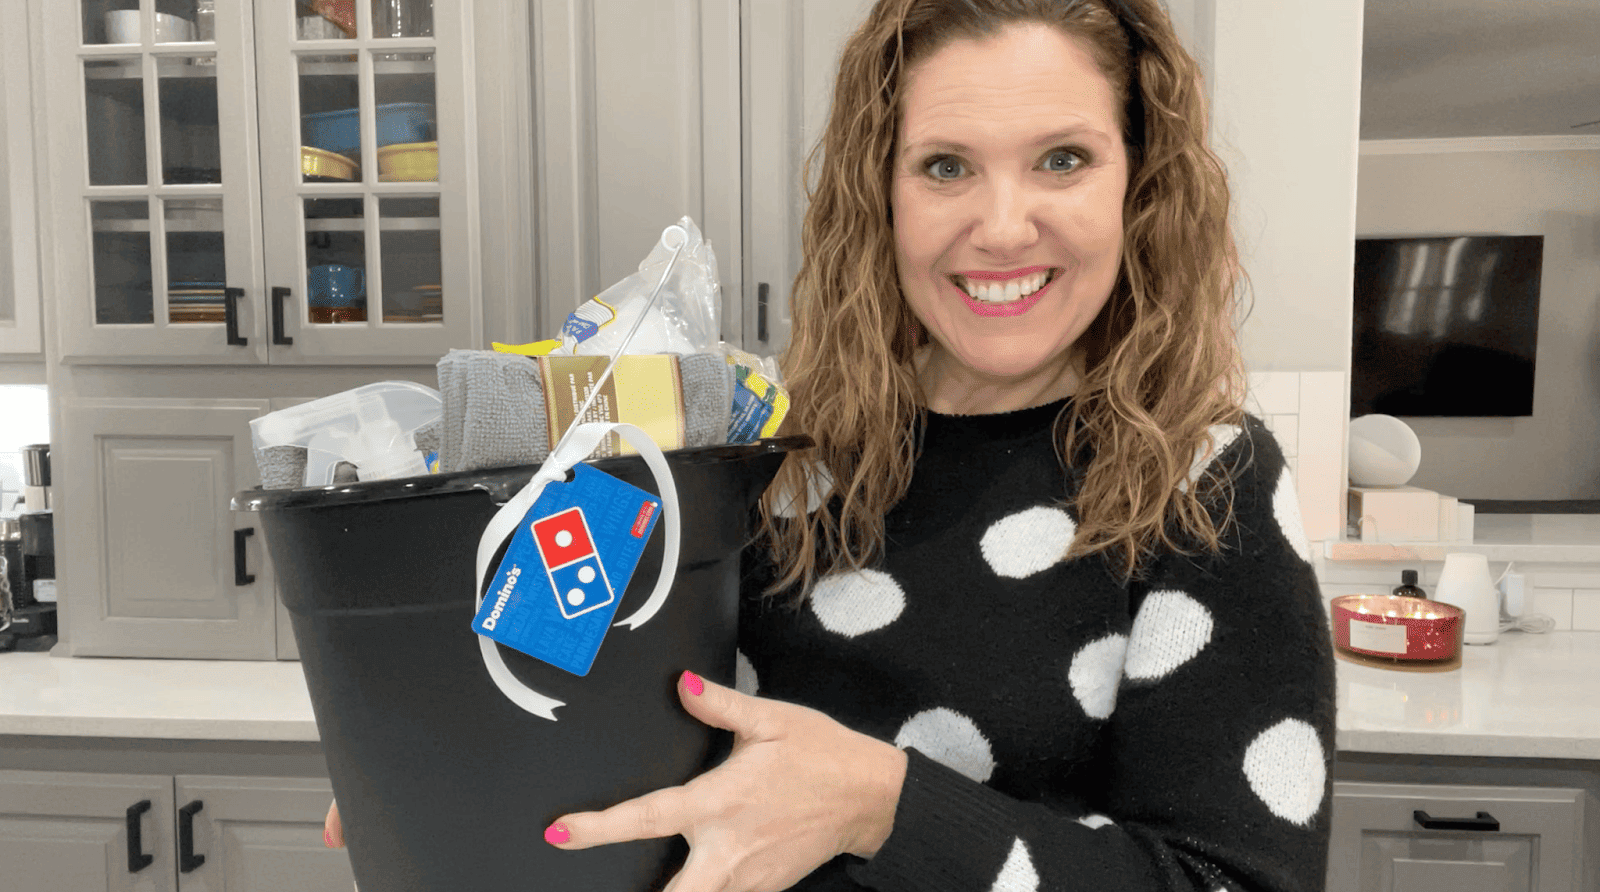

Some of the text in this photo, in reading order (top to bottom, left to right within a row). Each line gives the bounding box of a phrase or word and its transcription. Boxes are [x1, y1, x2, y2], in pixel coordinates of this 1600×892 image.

[598, 486, 633, 535] WINGS
[482, 566, 521, 631] Domino's
[569, 607, 607, 670] PARMESAN
[615, 538, 638, 569] BITES
